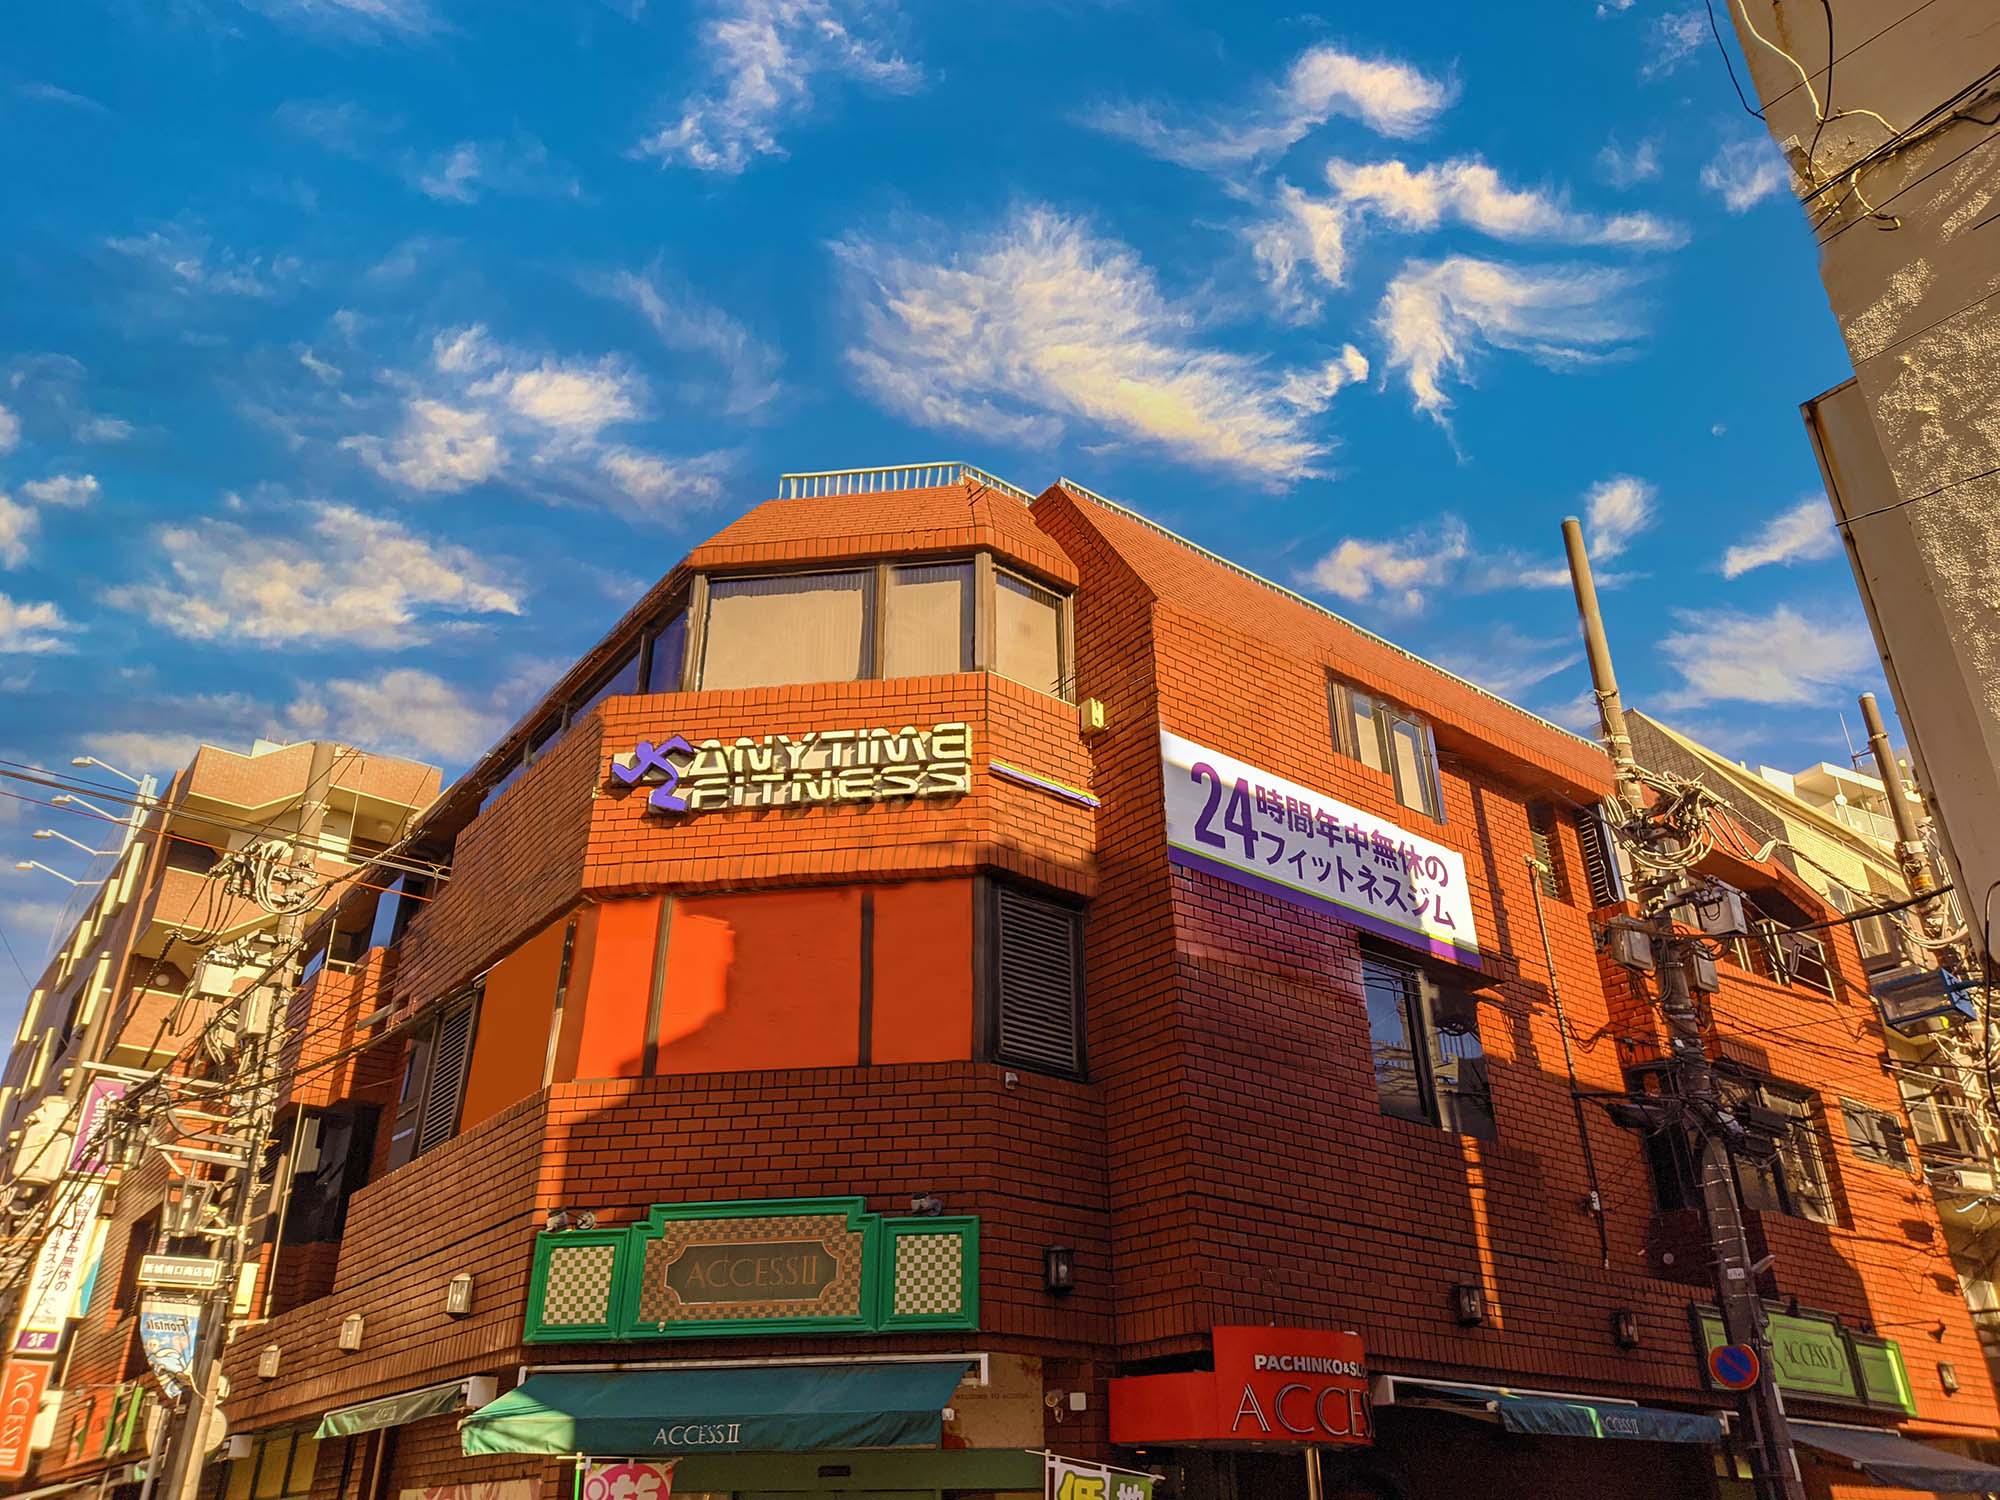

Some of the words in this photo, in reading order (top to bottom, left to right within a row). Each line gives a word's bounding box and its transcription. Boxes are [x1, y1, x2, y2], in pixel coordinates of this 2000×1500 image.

[687, 722, 970, 777] ANYTIME
[690, 763, 970, 809] FITNESS
[1190, 761, 1448, 888] 24時間年中無休の
[1260, 830, 1456, 930] フィットネスジム
[27, 1333, 49, 1348] 3F
